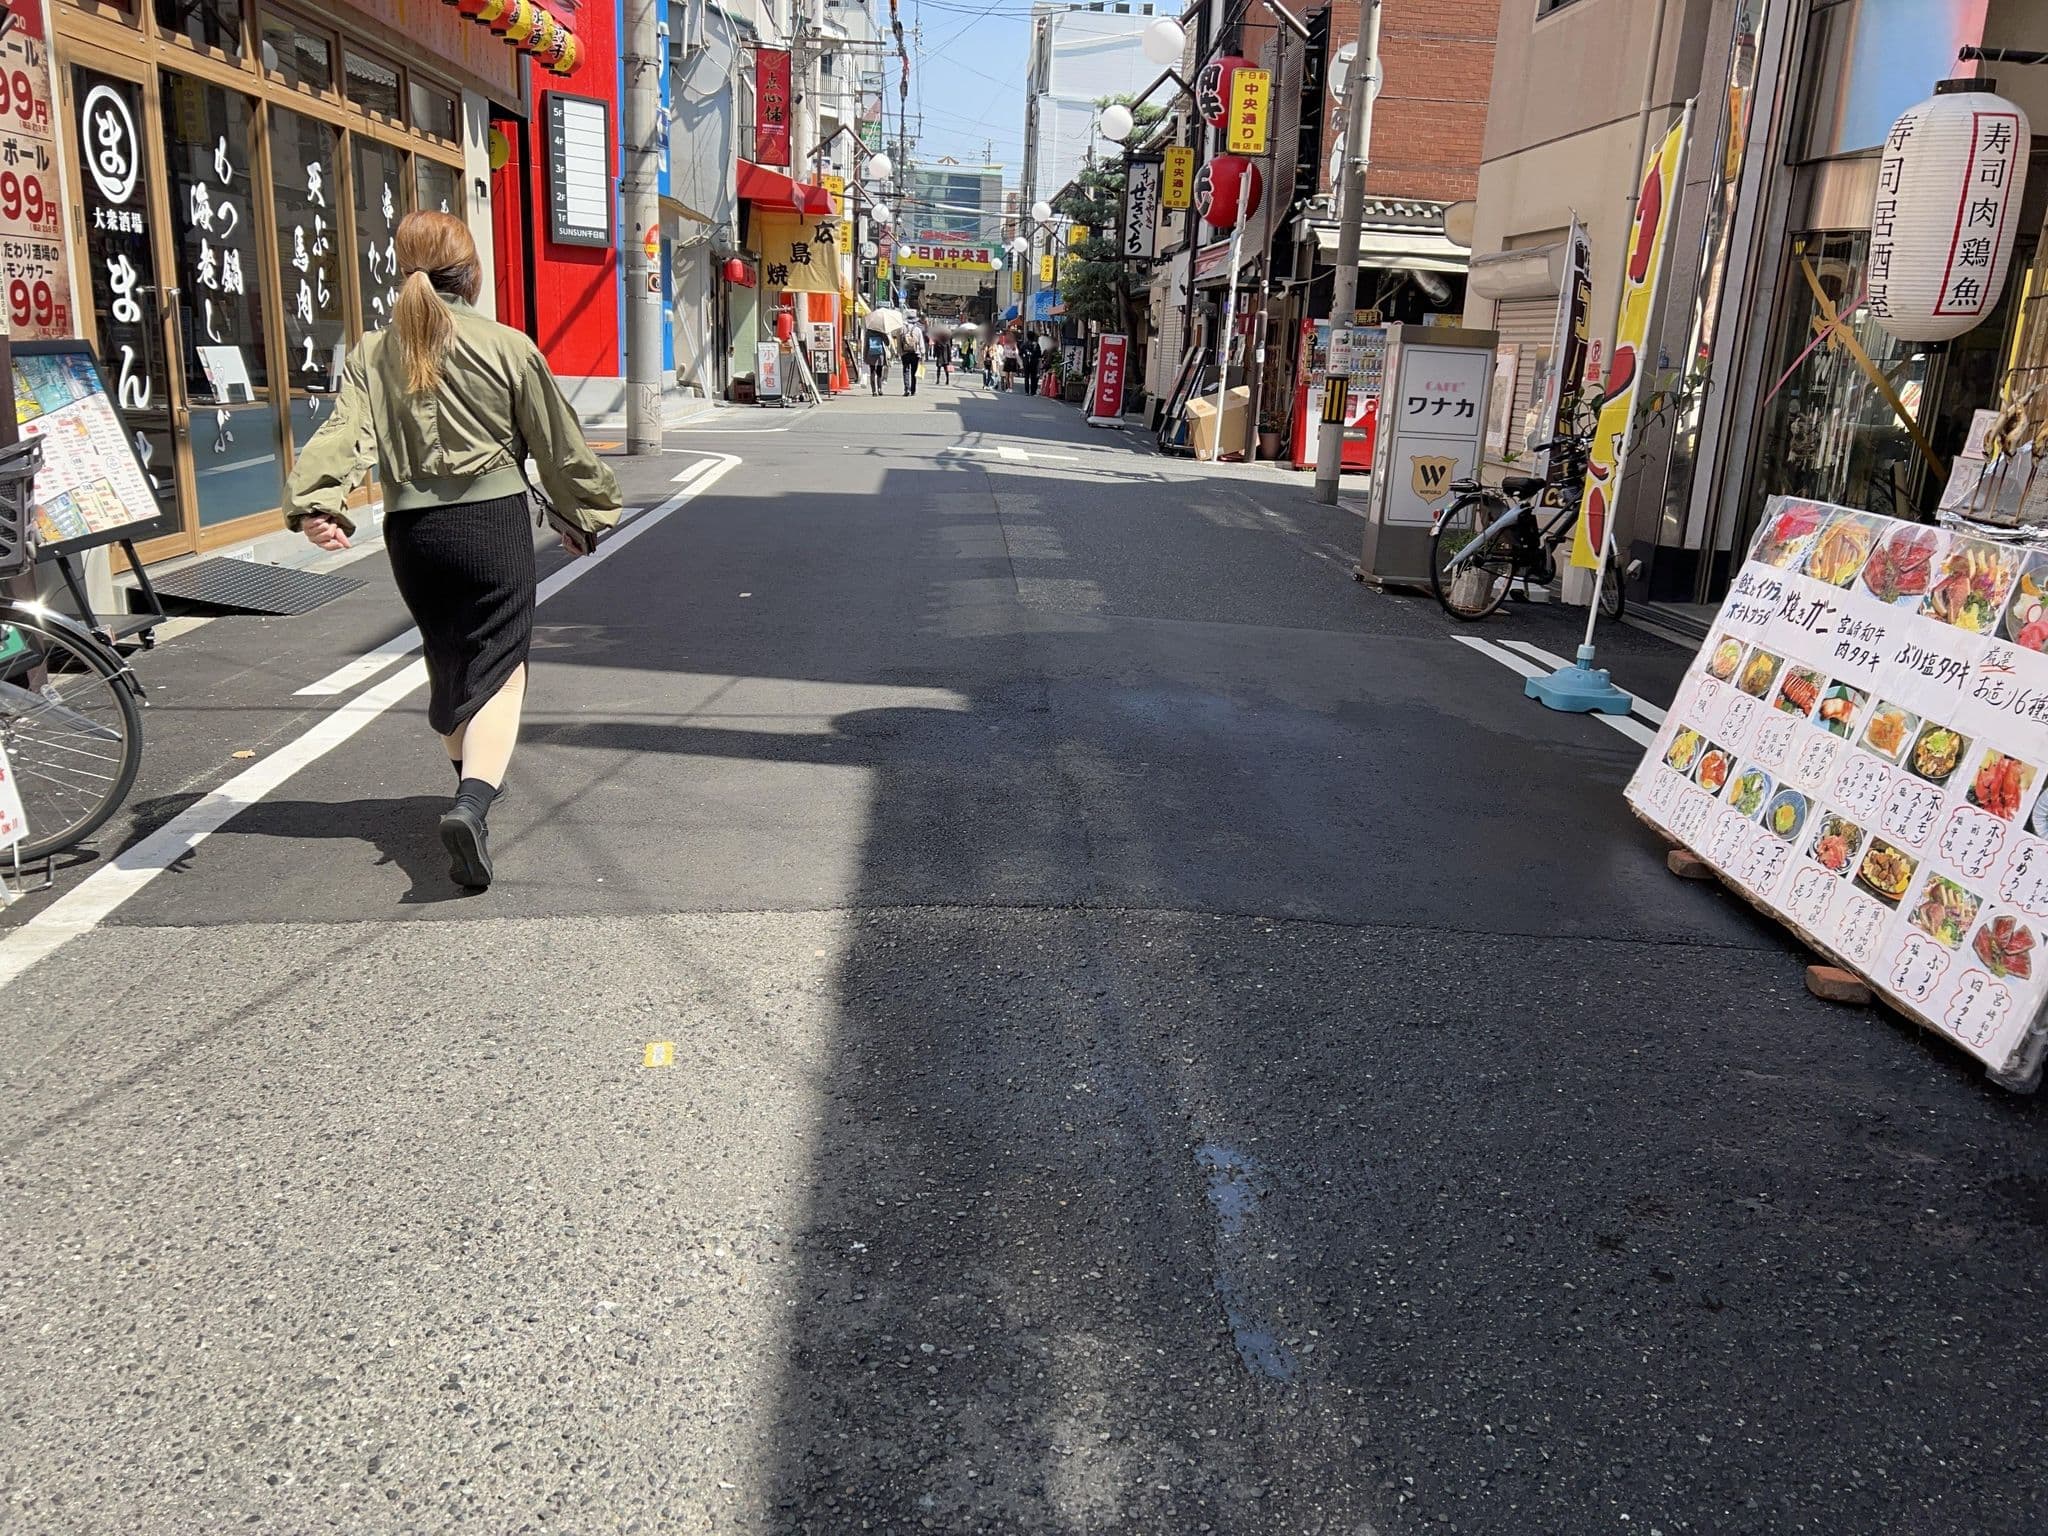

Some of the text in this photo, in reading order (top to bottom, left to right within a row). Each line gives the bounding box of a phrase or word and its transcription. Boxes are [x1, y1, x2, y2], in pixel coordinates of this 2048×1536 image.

[0, 39, 38, 67] ール
[1238, 71, 1268, 80] 千日前
[553, 108, 563, 117] 5F
[1241, 83, 1259, 139] 中央通り
[554, 136, 564, 146] 4F
[555, 164, 565, 174] 3F
[1173, 158, 1186, 198] 中央通り
[556, 192, 566, 201] 2F
[93, 207, 144, 235] 大衆酒場
[215, 136, 244, 296] もつ鍋
[557, 214, 567, 223] 1F
[1128, 182, 1147, 254] せきぐち
[1948, 122, 2011, 306] 寿司肉鶏魚
[306, 161, 330, 307] 天ぷら
[0, 242, 59, 262] だわり酒場の
[2, 261, 54, 280] モンサワー
[1102, 351, 1118, 402] たばこ
[1408, 397, 1475, 418] ワナカ
[1421, 464, 1446, 487] W
[1837, 614, 1886, 646] 宮崎和牛
[1834, 640, 1881, 673] 肉タタキ
[1894, 643, 1972, 690] ぶり塩タタキ
[1911, 794, 1942, 844] ホルモン
[1969, 823, 2000, 875] ホタルイカ
[2005, 847, 2034, 902] なめろう
